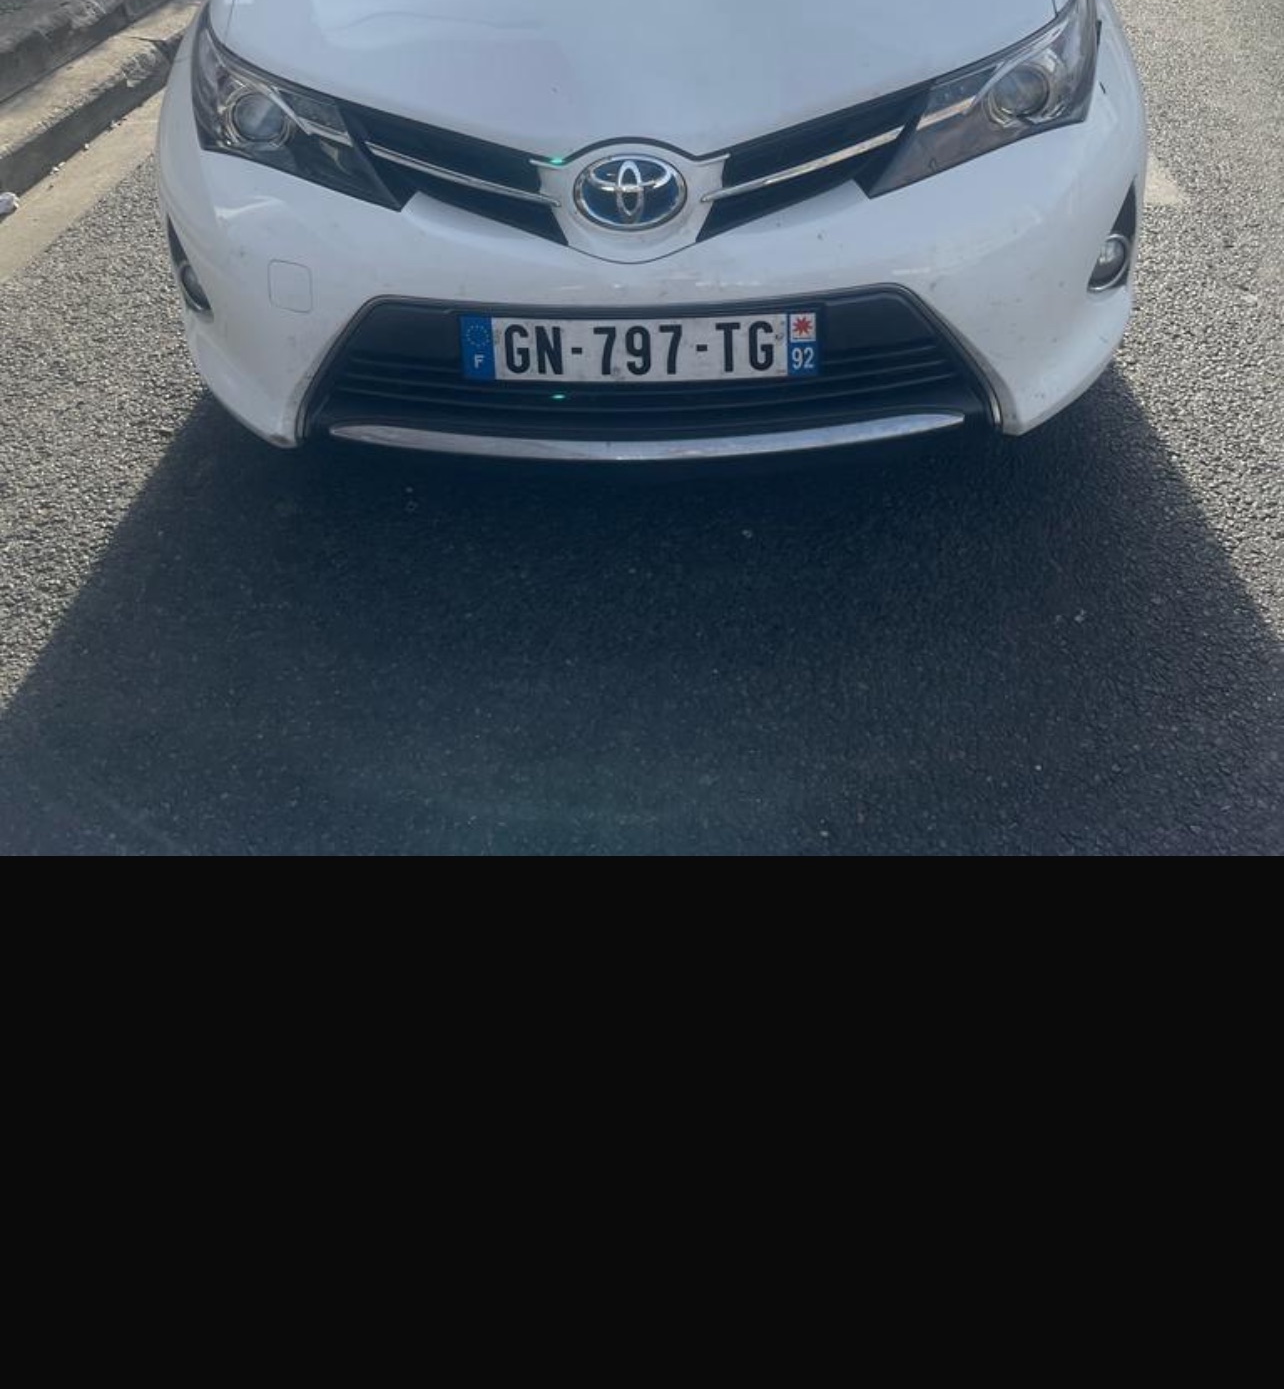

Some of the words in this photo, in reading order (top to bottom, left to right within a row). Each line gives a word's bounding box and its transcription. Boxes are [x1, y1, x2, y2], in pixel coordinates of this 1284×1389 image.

[504, 321, 774, 375] GN-797-TG
[791, 347, 814, 369] 92
[474, 354, 484, 368] F
